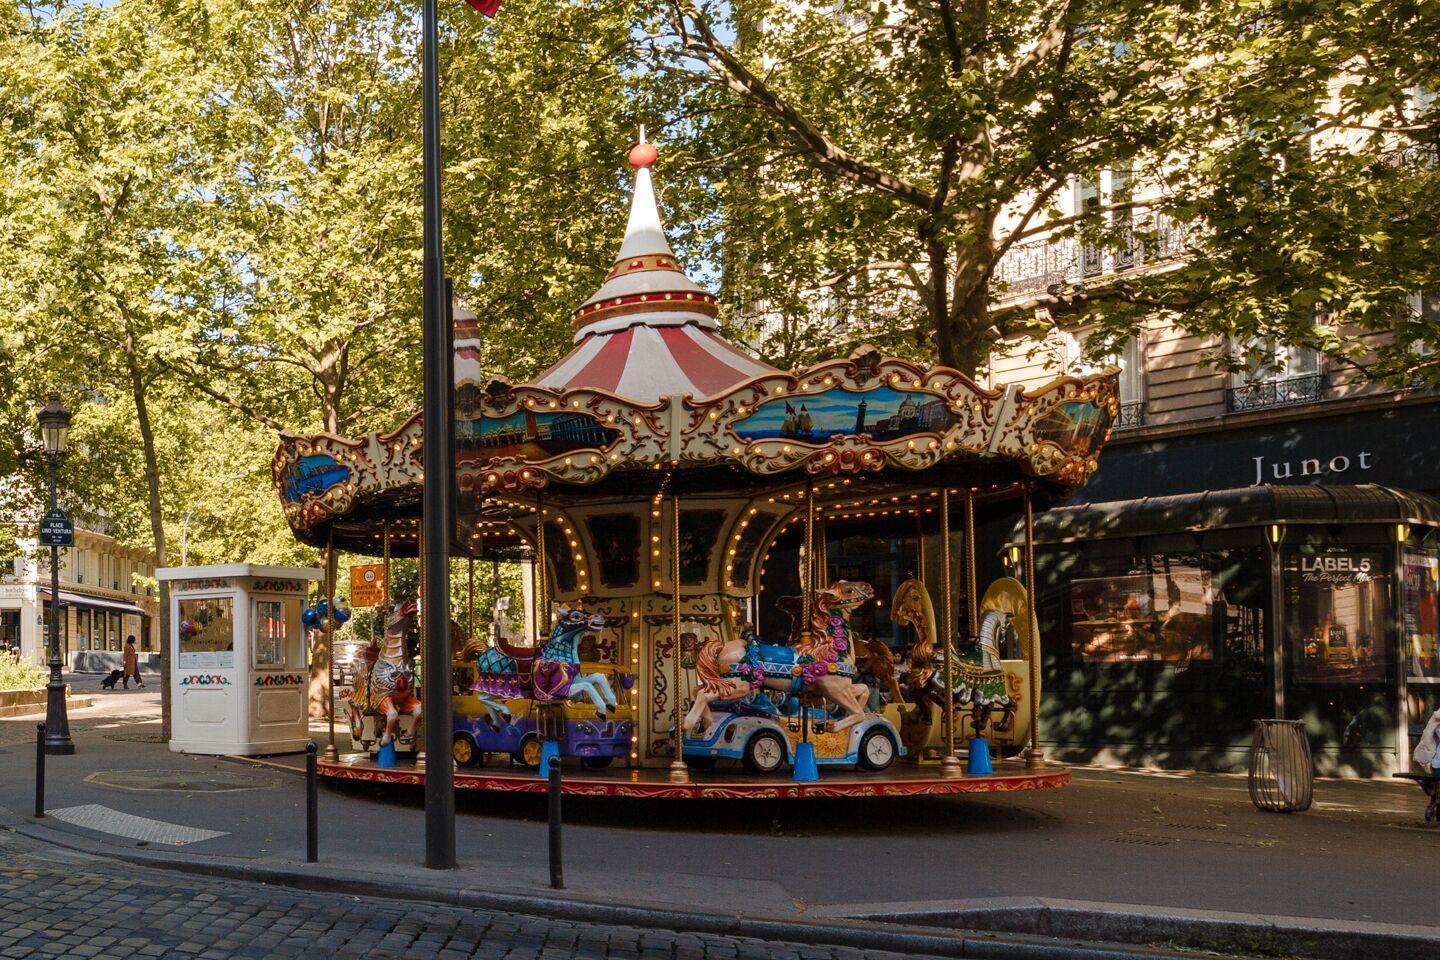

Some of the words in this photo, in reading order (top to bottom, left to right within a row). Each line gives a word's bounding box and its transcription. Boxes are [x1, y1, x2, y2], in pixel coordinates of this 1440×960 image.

[1249, 451, 1372, 488] Junot
[1302, 557, 1359, 572] LABEL
[1360, 558, 1371, 572] 5
[1302, 572, 1319, 582] The
[1320, 571, 1352, 583] Perfect
[1353, 571, 1371, 583] Mix
